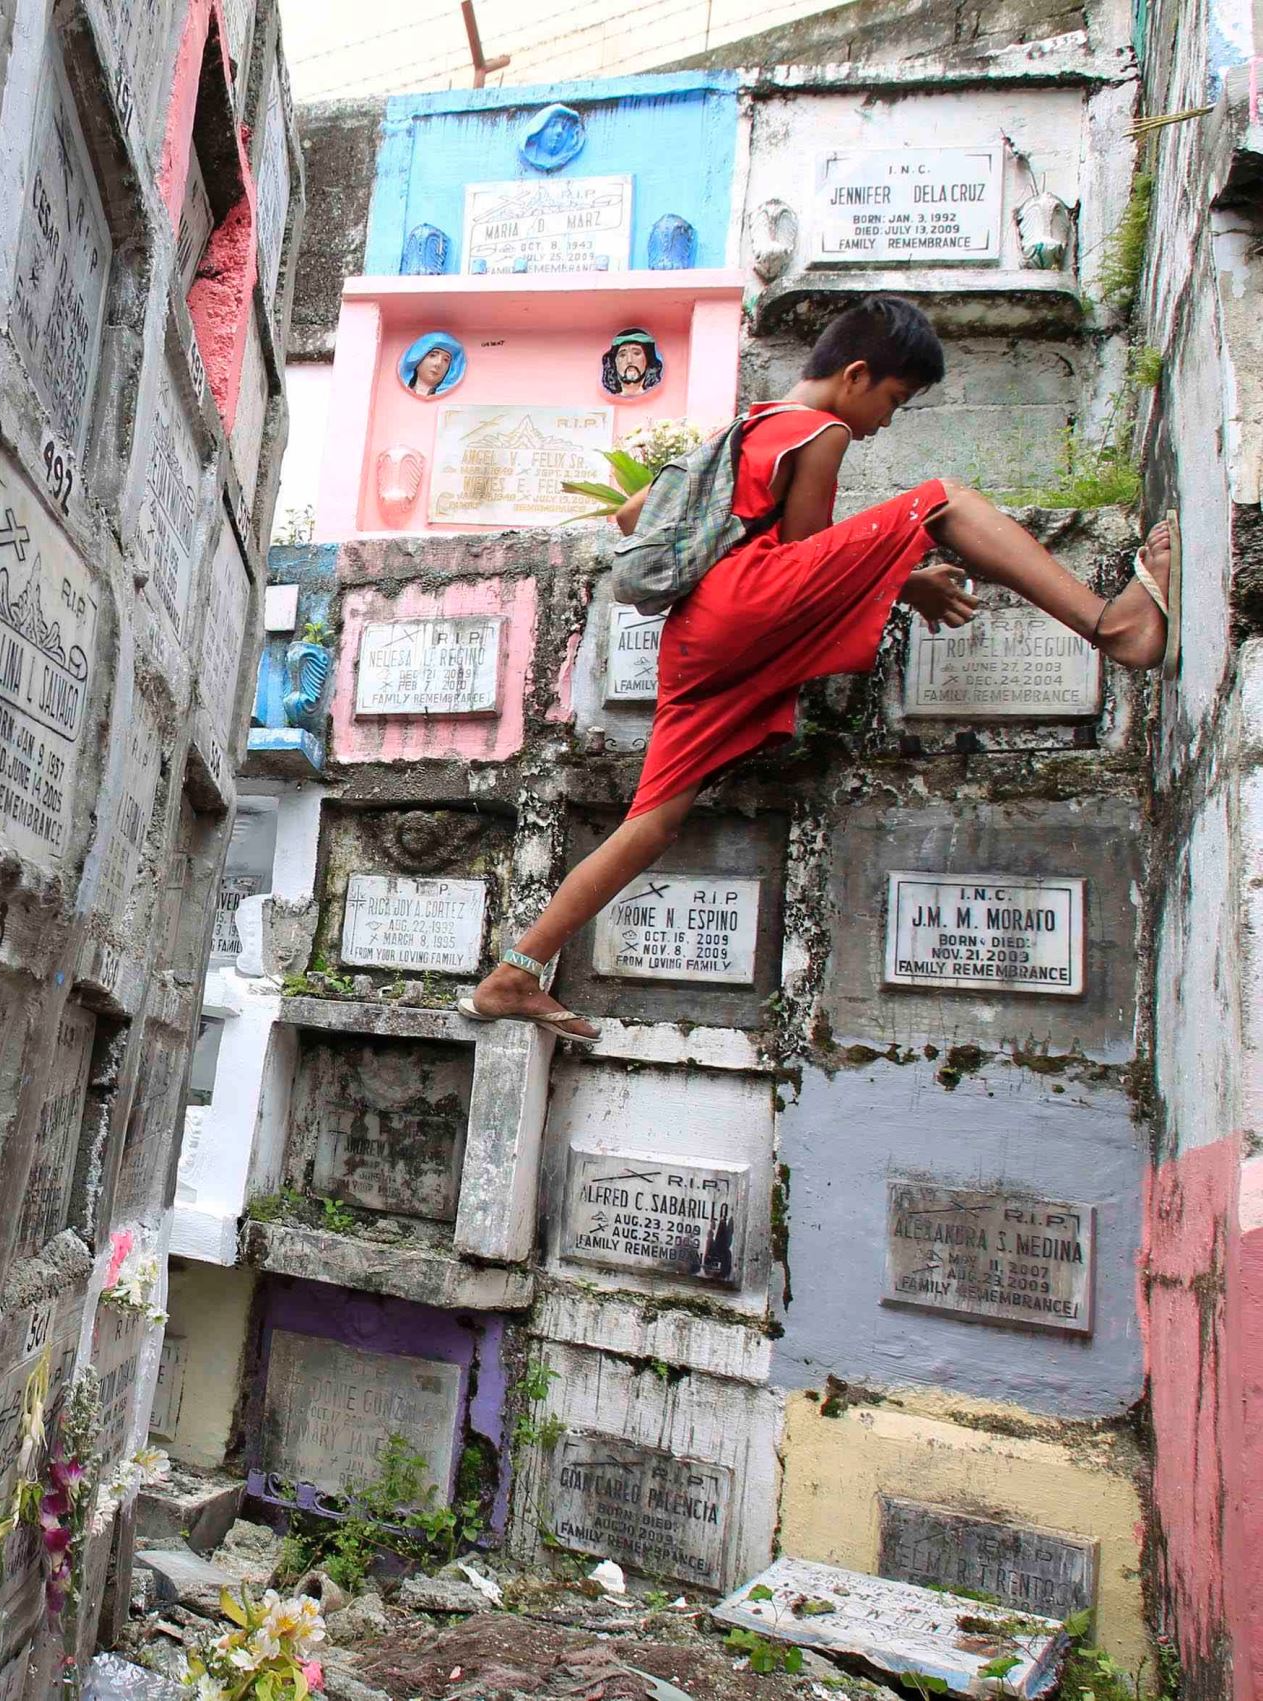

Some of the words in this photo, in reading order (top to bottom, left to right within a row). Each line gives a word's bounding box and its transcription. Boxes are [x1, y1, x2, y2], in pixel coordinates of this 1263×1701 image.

[830, 185, 891, 205] JENNIFER
[951, 183, 985, 202] CRUZ
[931, 213, 956, 222] 1992
[485, 222, 519, 240] MARIA
[885, 225, 911, 235] JULY
[931, 224, 960, 234] 2009
[839, 238, 875, 250] FAMILY
[888, 237, 971, 249] REMEMBRANCE
[618, 631, 659, 651] ALLEN
[1023, 636, 1084, 657] SEGUIN
[962, 662, 997, 672] JUNE
[1023, 662, 1062, 672] 2003
[621, 680, 657, 690] FAMILY
[1023, 676, 1063, 686] 2004
[974, 689, 1080, 702] REMEMBRANCE
[425, 900, 466, 919] CORTEZ
[666, 908, 681, 928] N.
[688, 909, 738, 931] ESPINO
[957, 907, 979, 929] M.
[987, 908, 1055, 931] MORATO
[644, 931, 670, 943] OCT.
[697, 933, 729, 945] 2009
[939, 934, 977, 946] BORN
[991, 937, 1031, 949] DIED:
[376, 948, 395, 961] YOUR
[399, 950, 429, 964] LOVING
[430, 952, 464, 966] FAMILY
[643, 945, 670, 956] NOV.
[696, 947, 728, 959] 2009
[932, 949, 964, 961] NOV.
[616, 955, 643, 968] FROM
[649, 957, 681, 969] LOVING
[686, 960, 732, 972] FAMILY
[898, 960, 946, 975] FAMILY
[952, 963, 1068, 981] REMEMBRANCE
[636, 1192, 648, 1212] C.
[651, 1194, 728, 1221] SABARILLO
[612, 1226, 641, 1241] AUG.
[614, 1214, 643, 1227] AUG.
[667, 1221, 701, 1236] 2009
[579, 1235, 620, 1251] FAMILY
[1017, 1234, 1084, 1264] MEDINA
[1009, 1261, 1049, 1279] 2007
[1007, 1276, 1050, 1293] 2009
[902, 1276, 952, 1296] FAMILY
[956, 1284, 1071, 1315] REMEMBRANCE
[648, 1488, 718, 1525] PALENCIA
[561, 1522, 604, 1543] FAMILY
